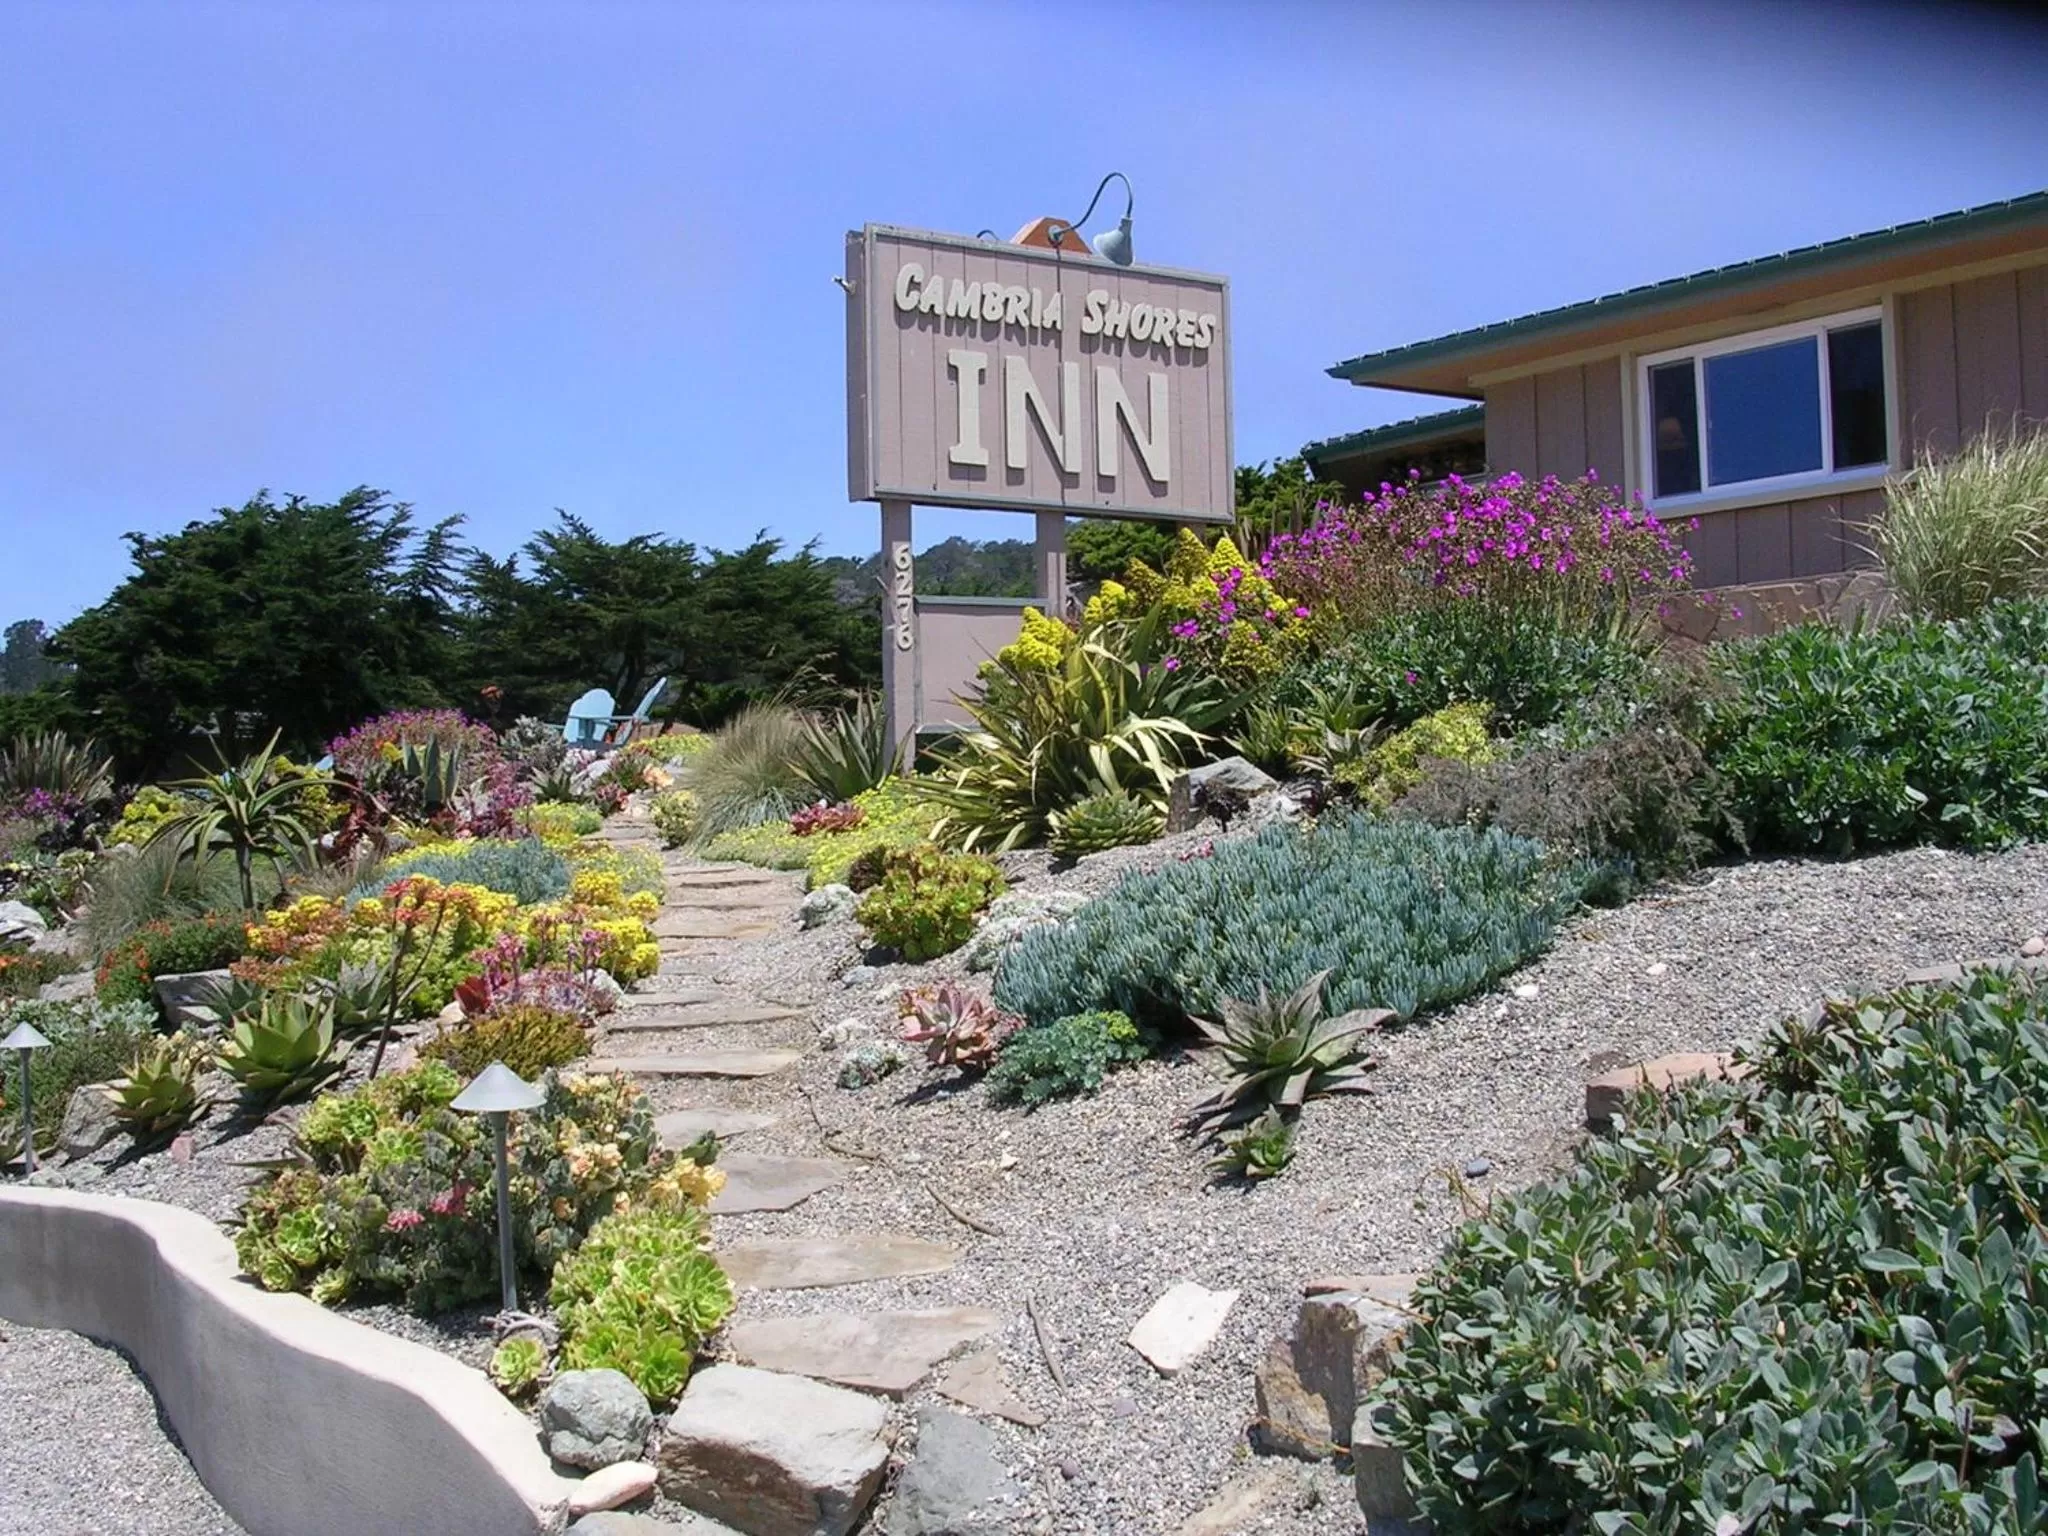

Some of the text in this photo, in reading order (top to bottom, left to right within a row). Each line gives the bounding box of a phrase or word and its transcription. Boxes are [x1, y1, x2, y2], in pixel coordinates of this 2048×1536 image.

[895, 263, 1217, 349] CAMBRIA SHORES
[948, 349, 1169, 482] INN
[895, 544, 913, 649] 6276
